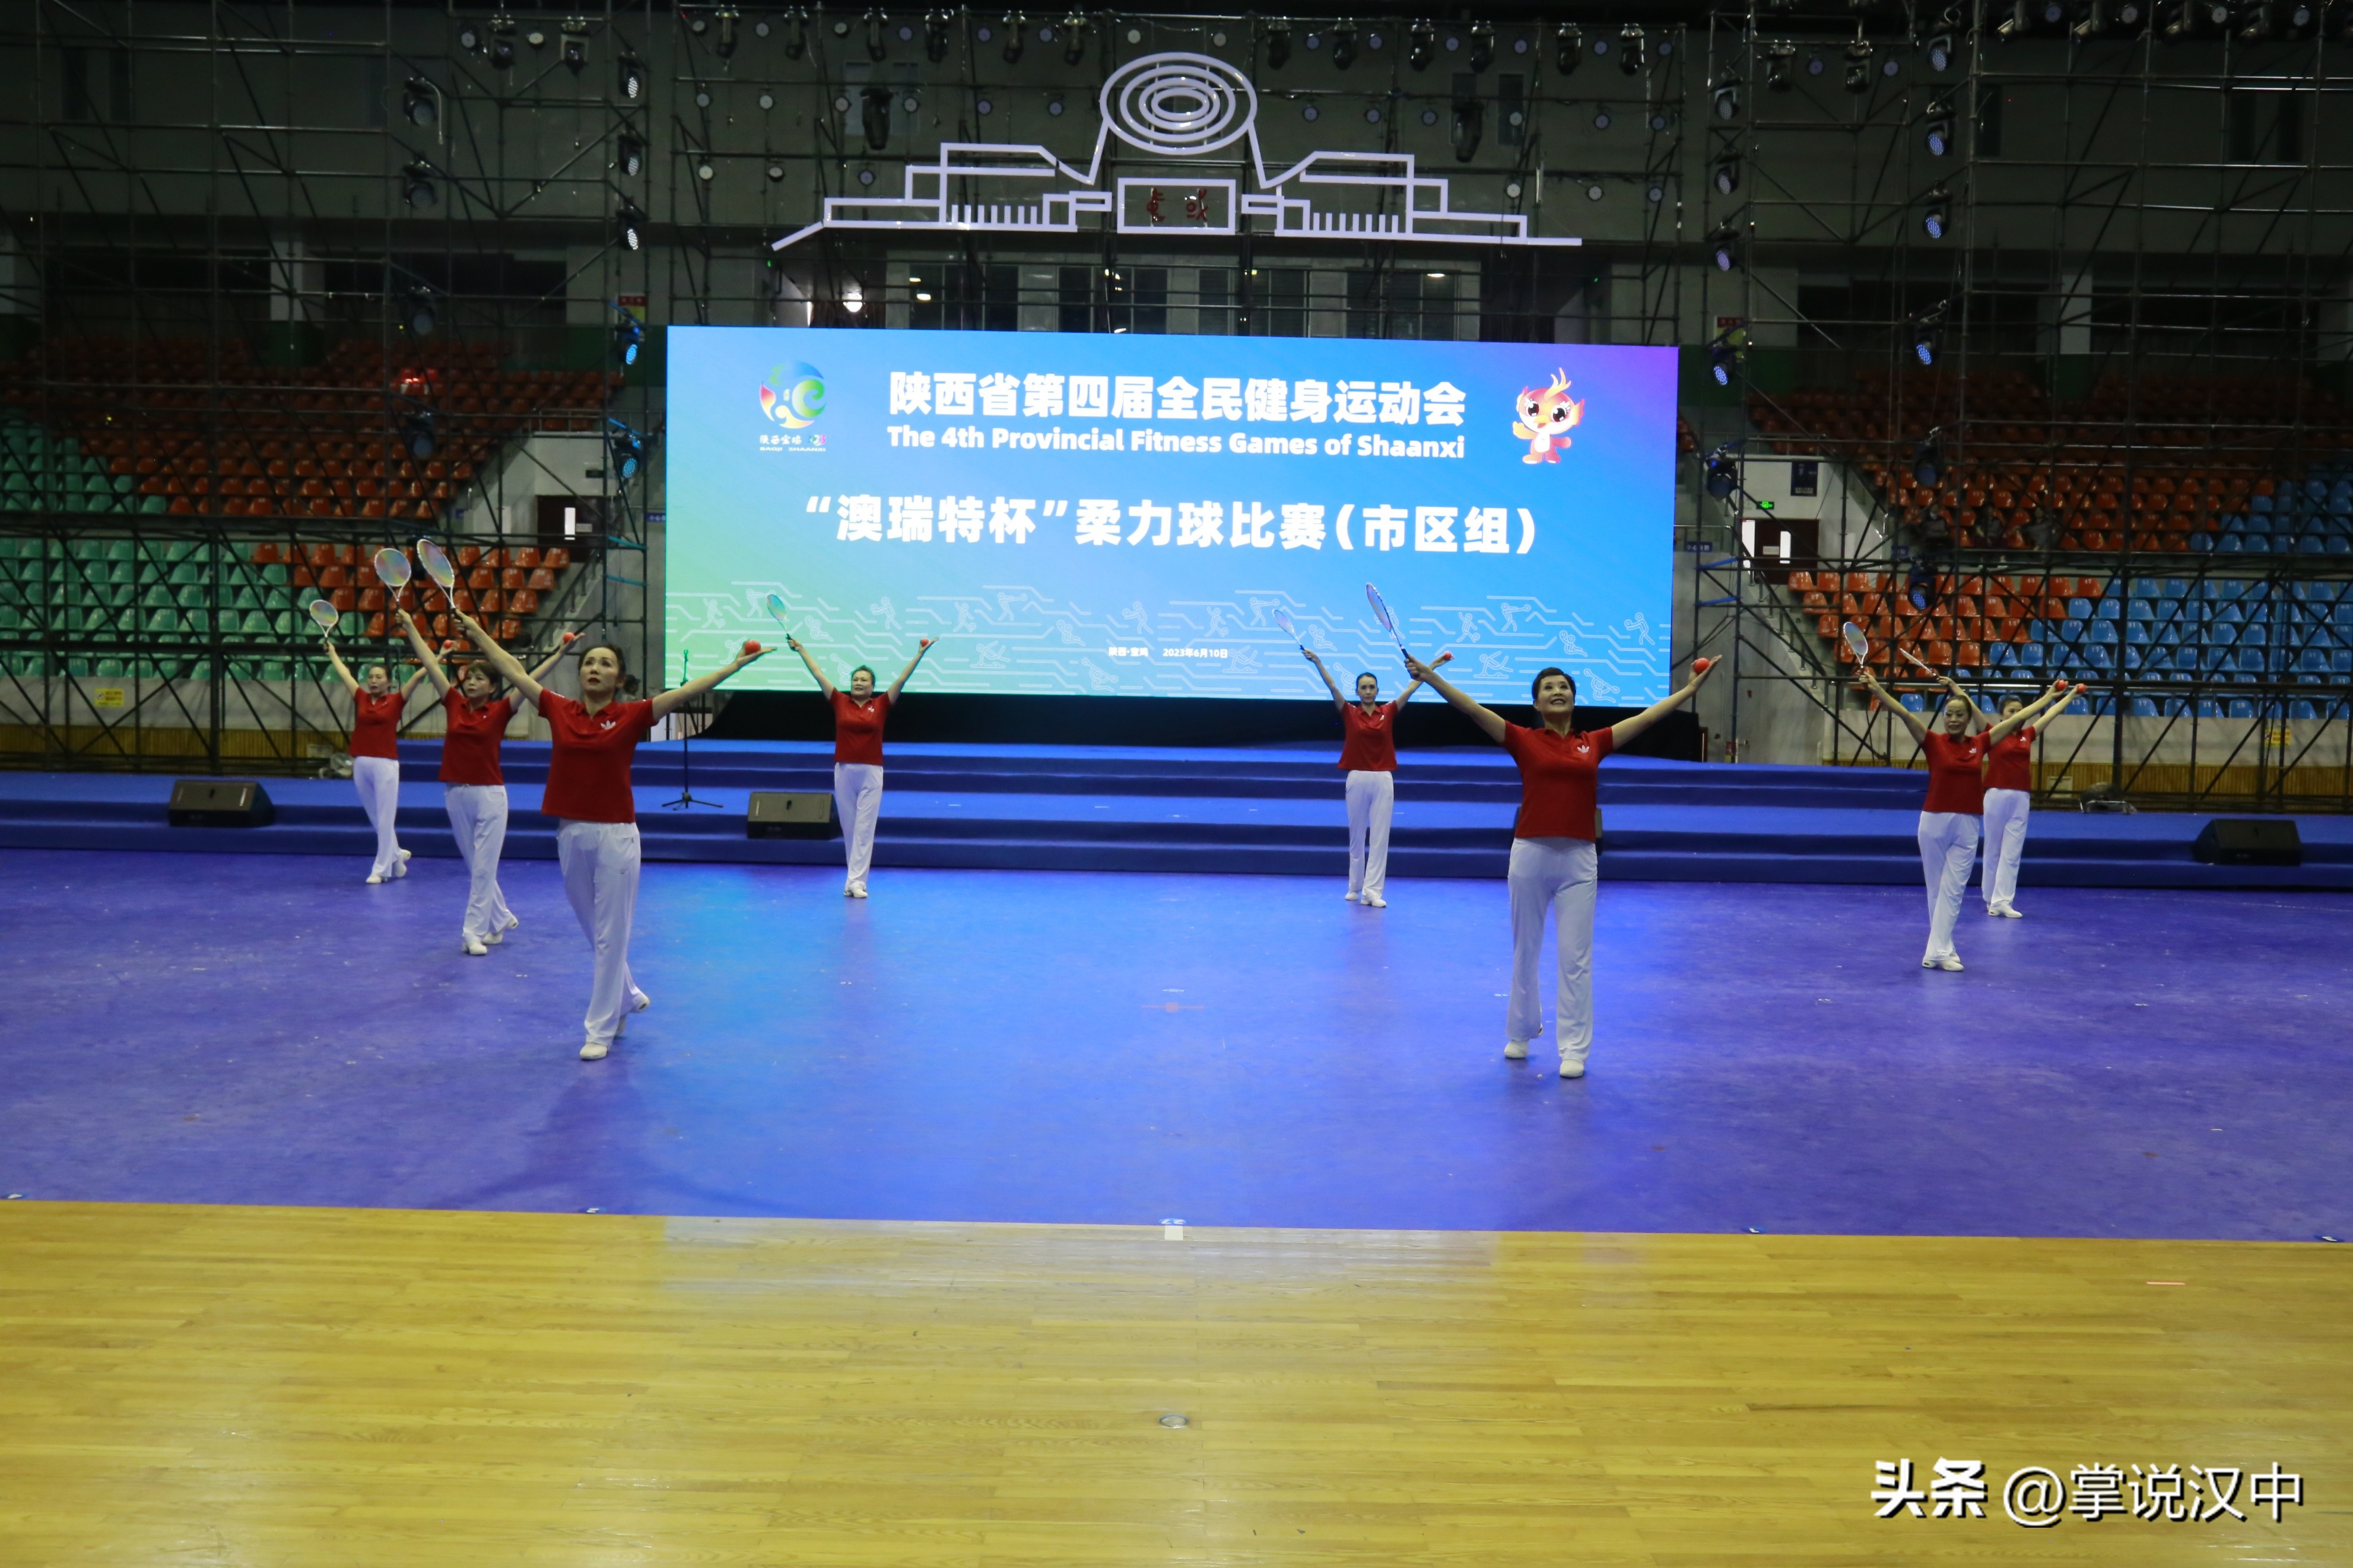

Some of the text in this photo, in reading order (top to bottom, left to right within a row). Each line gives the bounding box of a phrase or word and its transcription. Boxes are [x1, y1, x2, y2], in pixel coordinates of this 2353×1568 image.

[888, 371, 1466, 427] 陕西省第四届全民健身运动会
[887, 425, 1465, 459] The 4th Provincial Fitness Games of Shaanxi
[1163, 648, 1228, 659] 2023年6月10日
